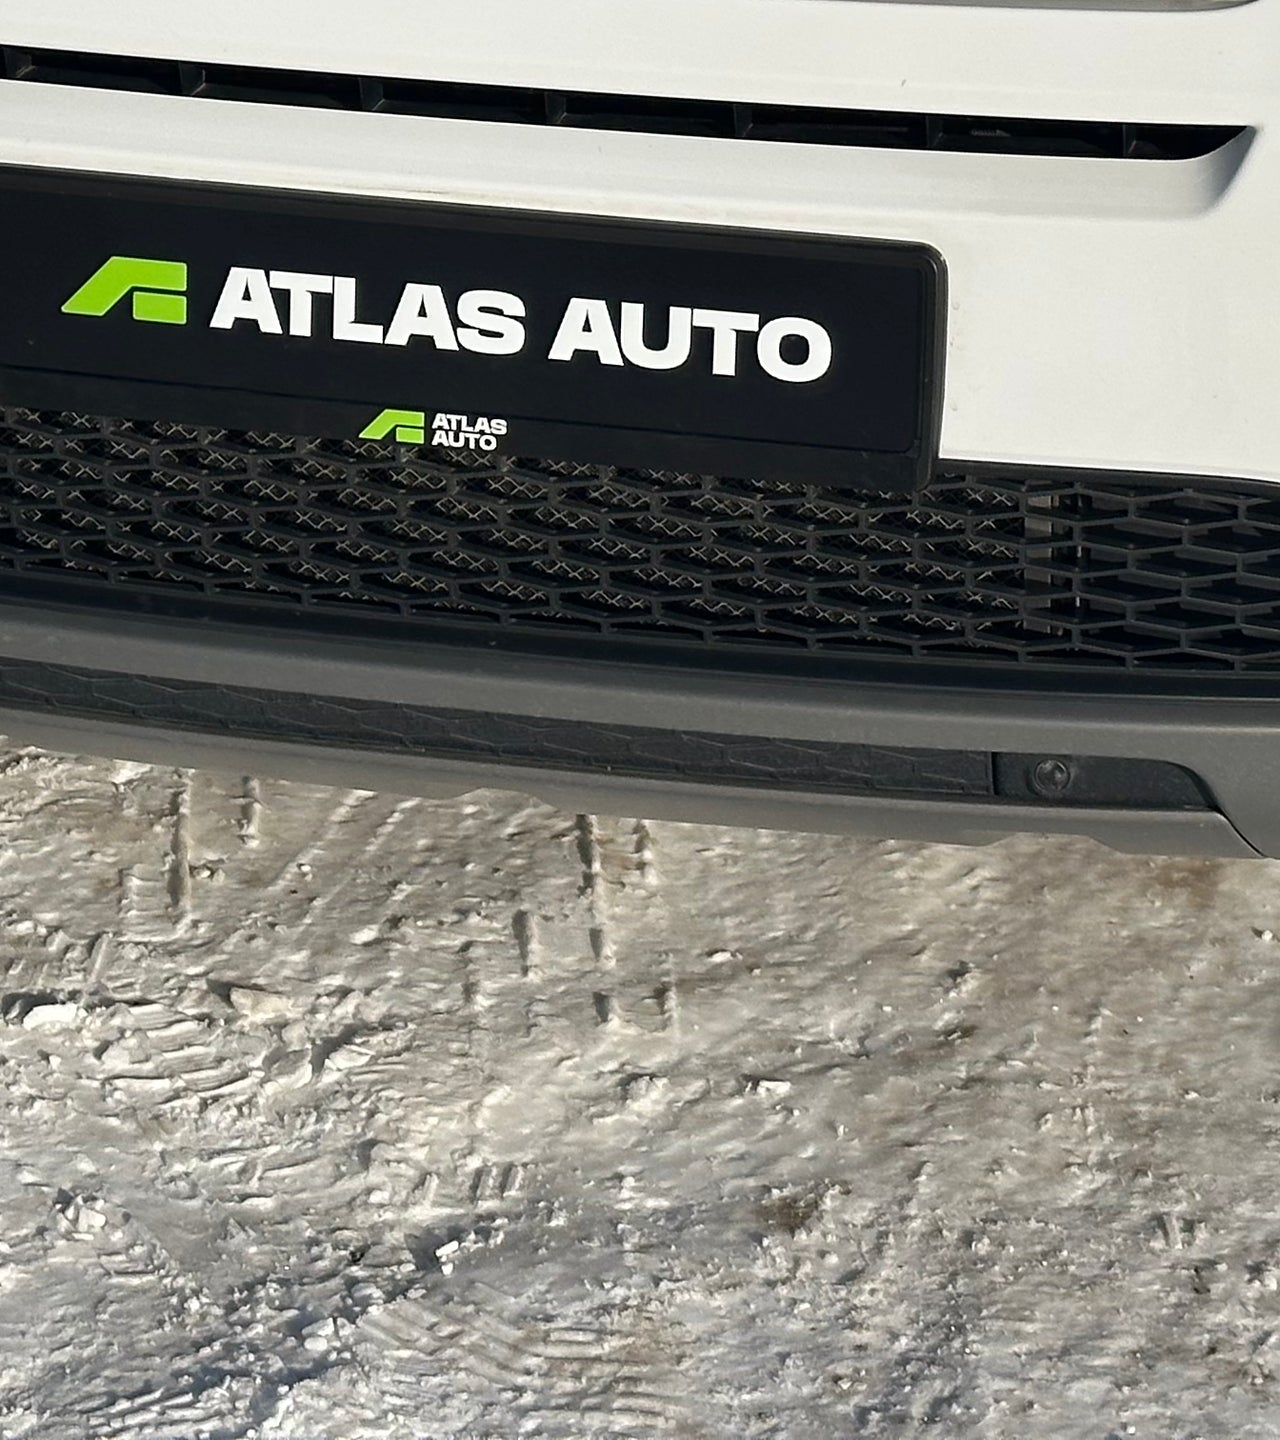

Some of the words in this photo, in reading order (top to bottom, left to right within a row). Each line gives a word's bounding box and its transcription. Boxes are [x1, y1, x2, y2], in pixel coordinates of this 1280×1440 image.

[210, 266, 526, 355] ATLAS
[548, 298, 832, 383] AUTO
[431, 413, 508, 435] ATLAS
[431, 430, 497, 451] AUTO
